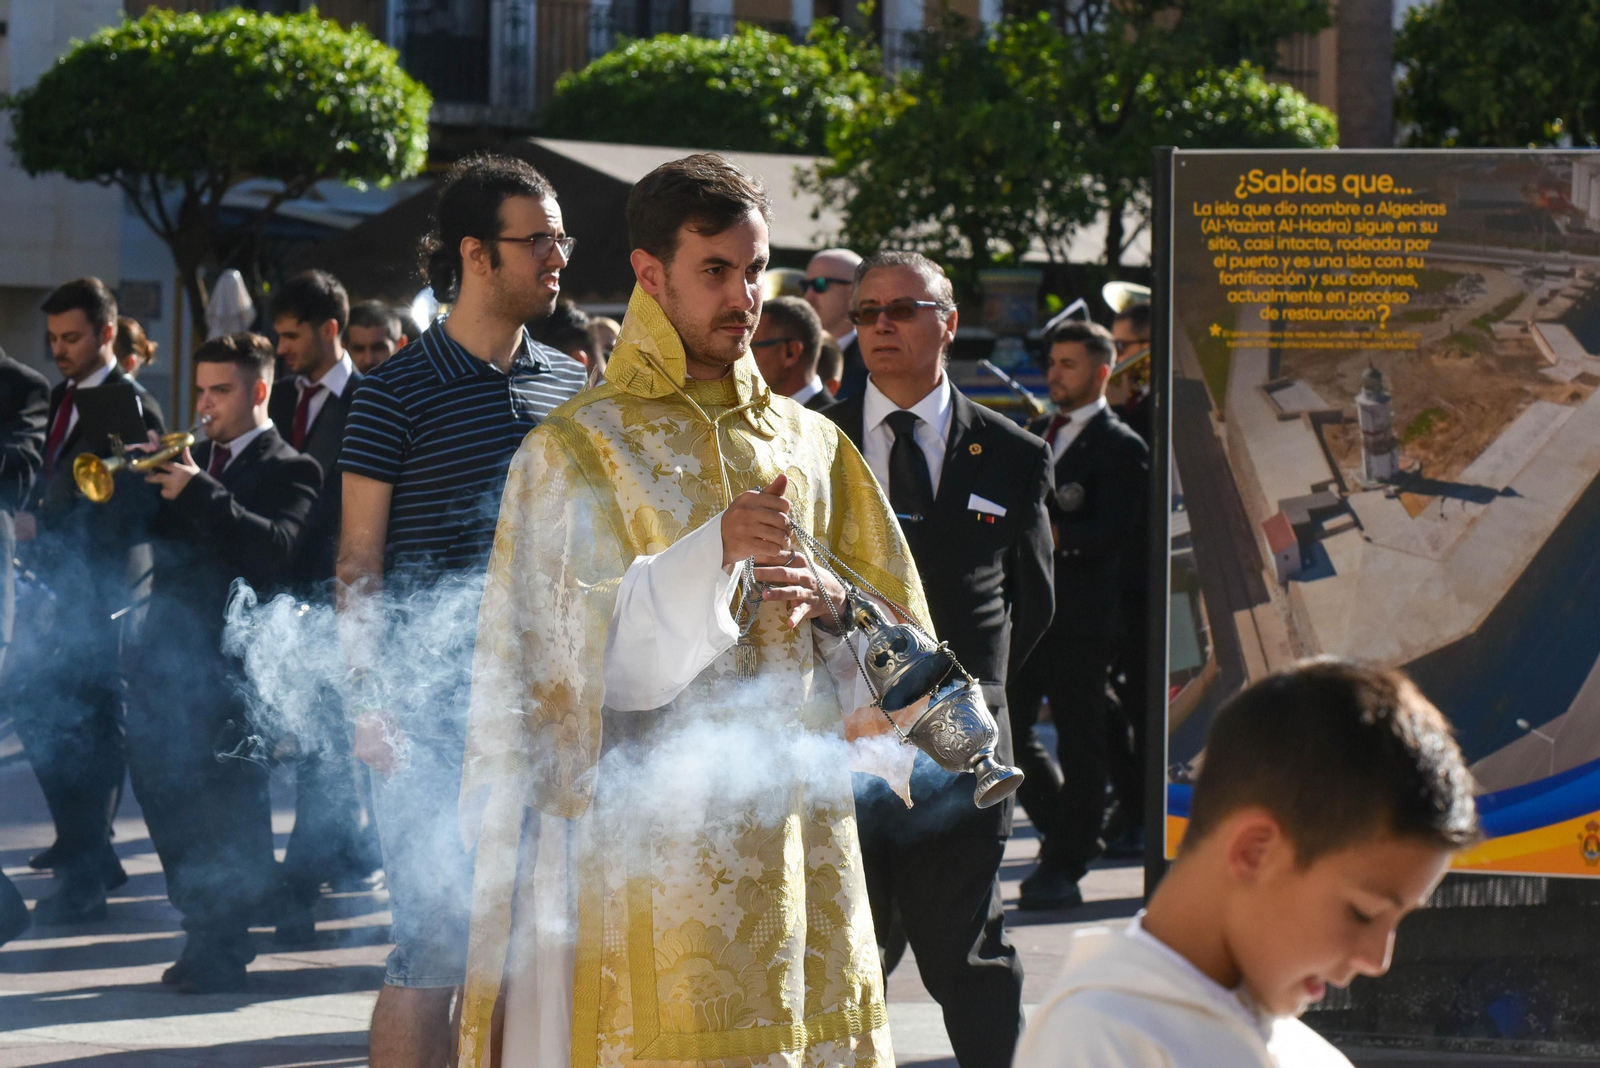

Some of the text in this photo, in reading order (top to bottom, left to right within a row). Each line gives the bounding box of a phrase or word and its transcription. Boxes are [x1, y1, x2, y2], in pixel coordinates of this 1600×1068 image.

[1235, 168, 1412, 199] ¿Sabías que...
[1194, 202, 1212, 215] La
[1215, 201, 1240, 215] isla
[1242, 203, 1272, 221] que
[1301, 201, 1361, 215] nombre
[1364, 203, 1375, 215] a
[1378, 201, 1446, 218] Algeciras
[1201, 218, 1438, 236] (Al-Yazirat Al-Hadra) sigue en su
[1208, 236, 1430, 253] sitio, casi intacta, rodeada por
[1214, 254, 1425, 272] el puerto y es una isla con su
[1219, 271, 1418, 290] fortificación y sus cañones,
[1227, 289, 1409, 306] actualmente en proceso
[1260, 304, 1391, 330] de restauración?
